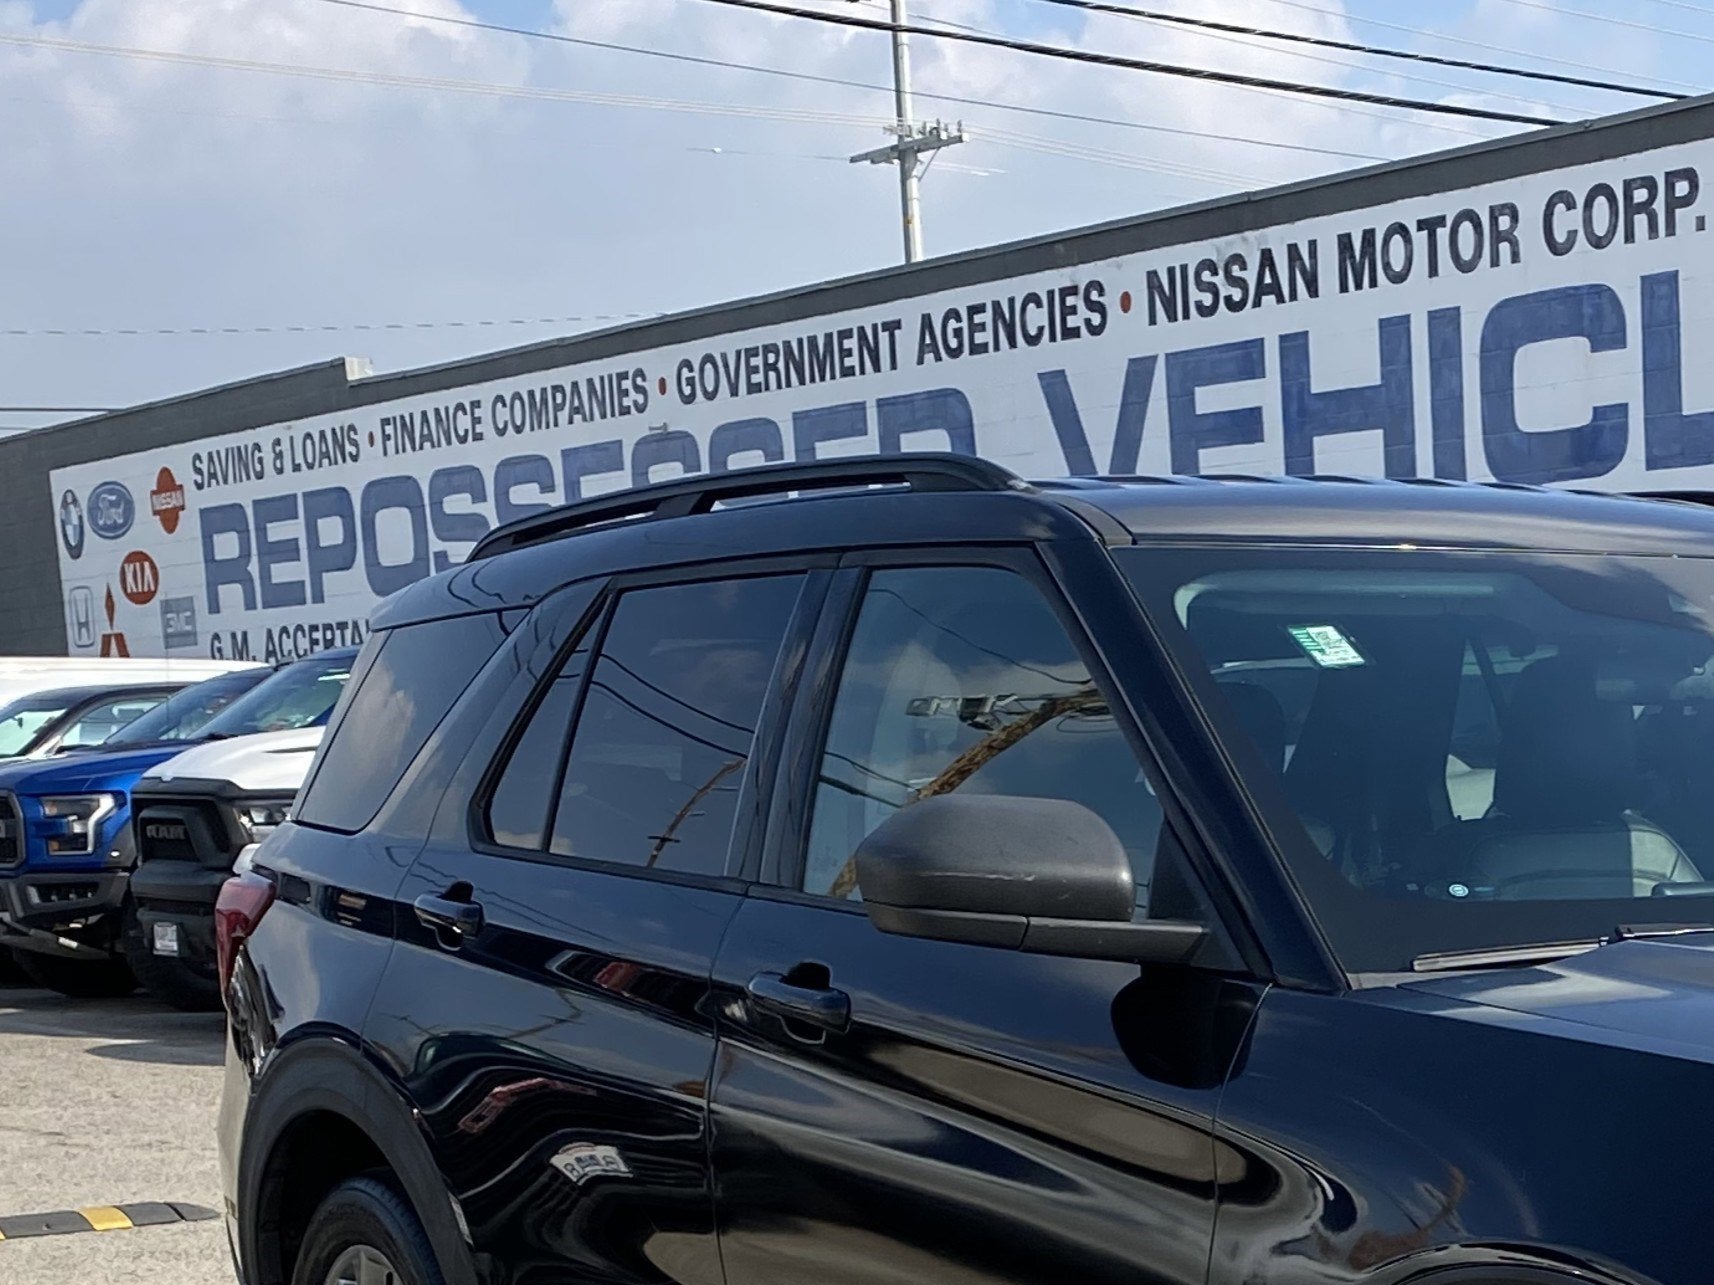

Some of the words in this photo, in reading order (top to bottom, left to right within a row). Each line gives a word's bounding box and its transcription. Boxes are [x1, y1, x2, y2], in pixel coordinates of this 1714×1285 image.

[191, 442, 265, 491] SAVING
[271, 437, 285, 476] &
[290, 424, 361, 473] LOANS
[380, 400, 484, 457] FINANCE
[491, 367, 649, 438] COMPANIES
[676, 319, 902, 405] GOVERNMENT
[916, 279, 1108, 367] AGENCIES
[1146, 239, 1320, 327] NISSAN
[1337, 202, 1521, 294] MOTOR
[1542, 166, 1707, 257] CORP.
